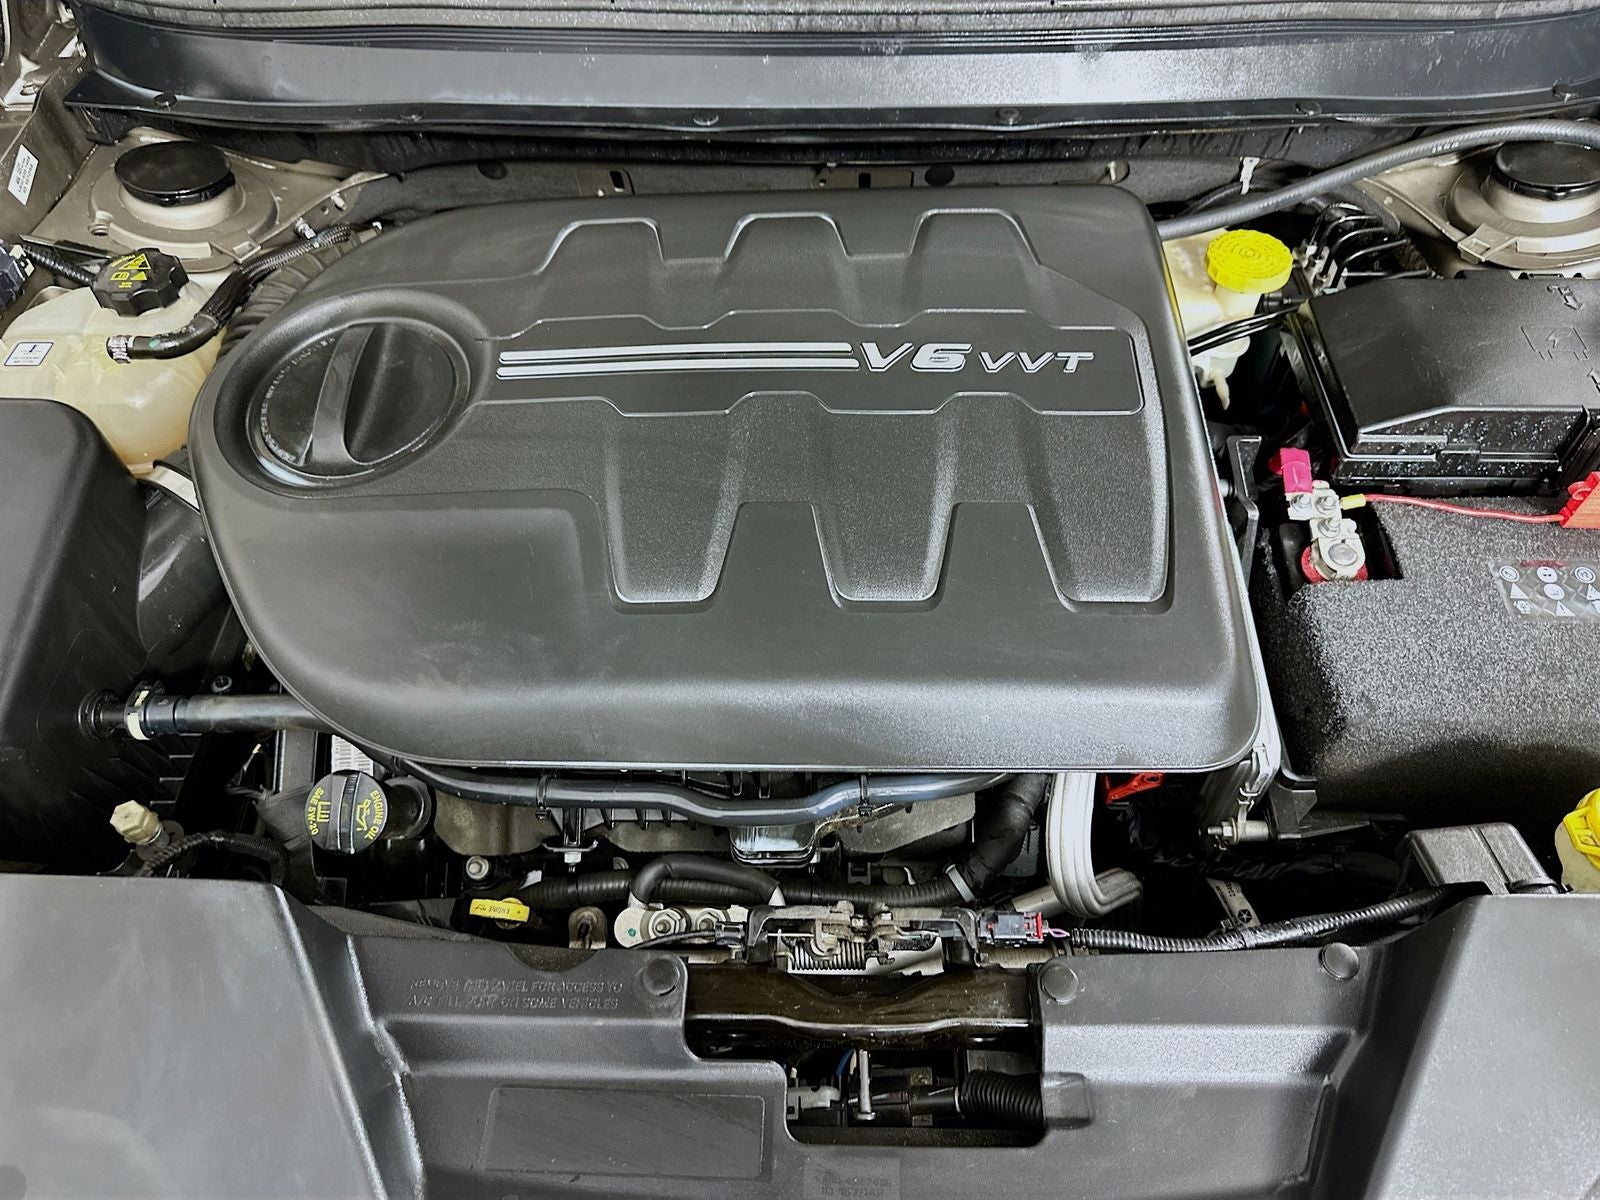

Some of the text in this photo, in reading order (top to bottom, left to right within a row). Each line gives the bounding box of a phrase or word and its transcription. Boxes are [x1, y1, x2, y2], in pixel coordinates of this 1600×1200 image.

[860, 342, 1094, 373] V6 VVT
[307, 787, 325, 836] SAE 5W-20
[364, 789, 384, 840] ENGINE OIL
[531, 980, 556, 993] FOR
[557, 980, 605, 993] ACCESS
[522, 996, 558, 1009] SOME
[561, 996, 621, 1010] VEHICLES
